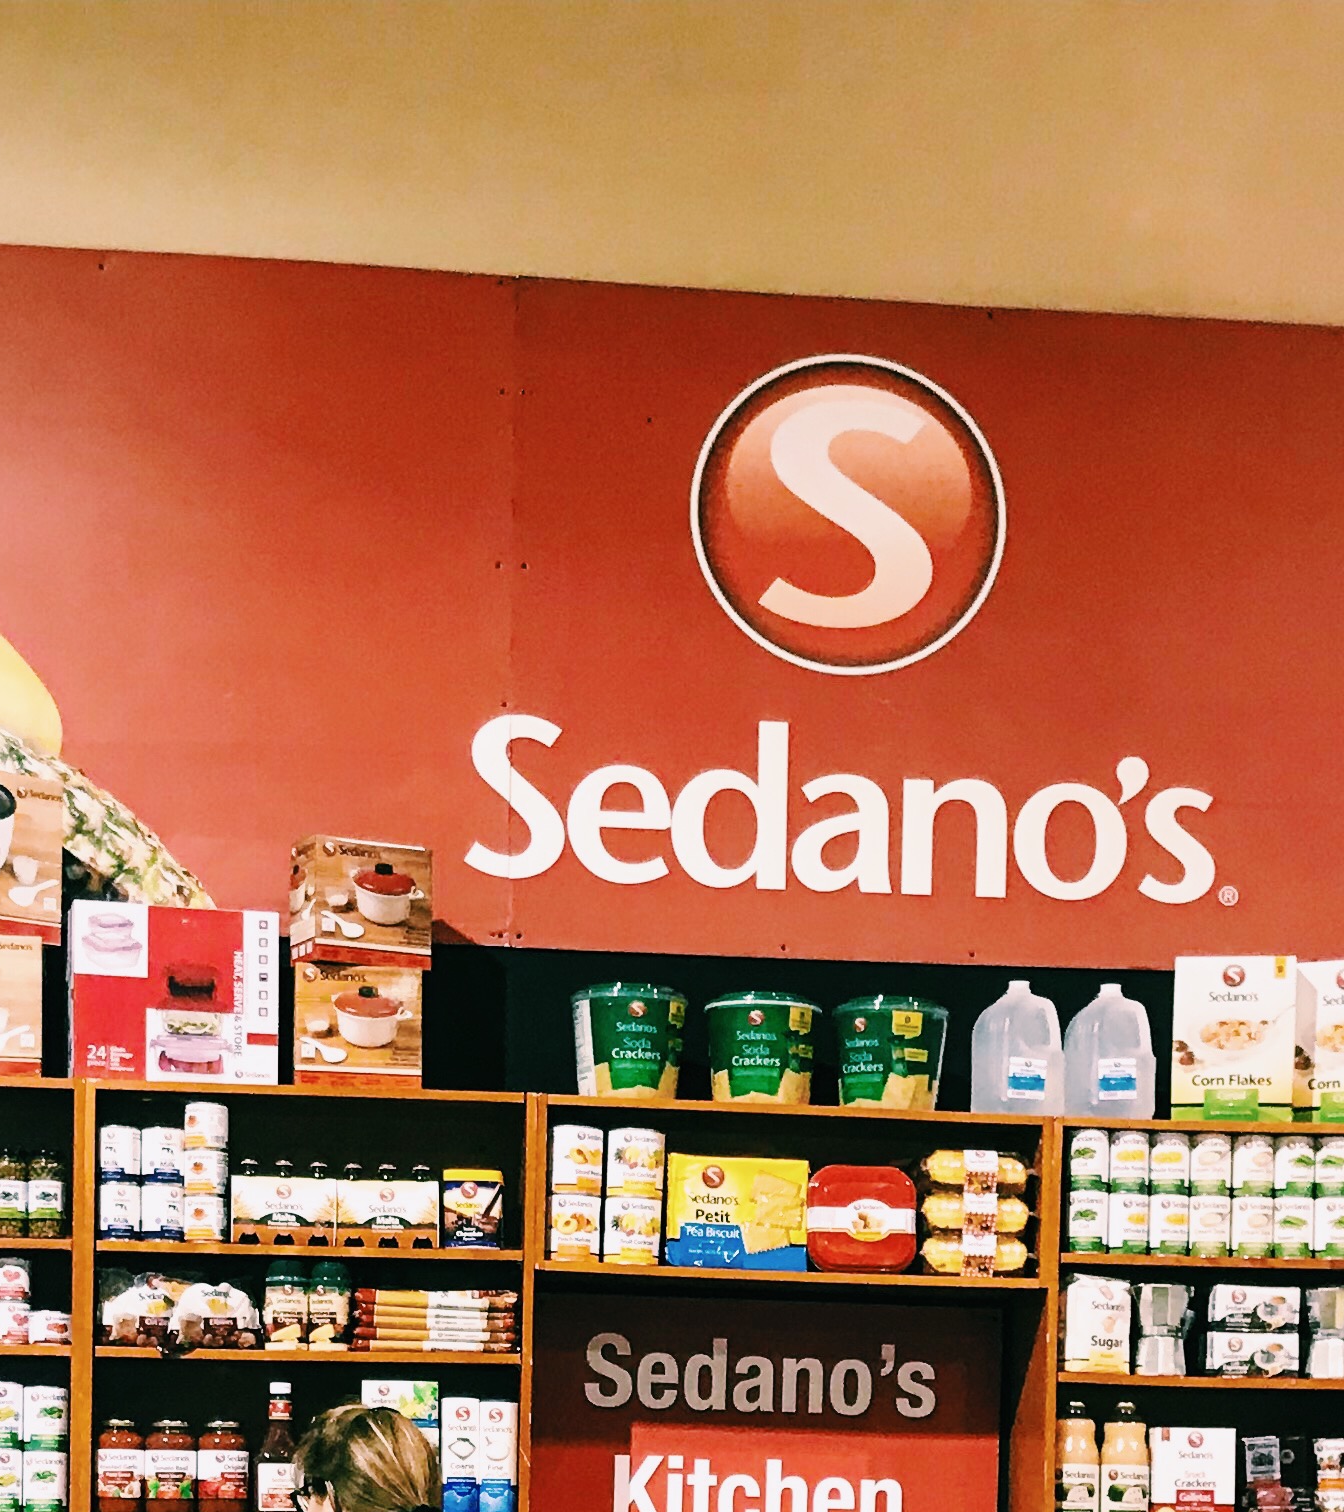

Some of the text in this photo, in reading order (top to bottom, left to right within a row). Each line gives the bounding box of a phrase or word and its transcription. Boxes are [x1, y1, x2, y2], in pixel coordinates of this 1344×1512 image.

[464, 713, 1216, 905] Sedano's
[623, 1036, 651, 1050] Soda
[742, 1043, 770, 1057] Soda
[86, 1044, 106, 1059] 24
[611, 1047, 661, 1061] Crackers
[848, 1050, 874, 1063] Soda
[731, 1055, 781, 1067] Crackers
[842, 1061, 884, 1074] Crackers
[1191, 1073, 1272, 1088] Corn Flakes
[1308, 1077, 1341, 1091] Corn
[695, 1208, 731, 1224] Petit
[706, 1225, 741, 1239] Biscuit
[1090, 1334, 1124, 1350] Sugar
[583, 1332, 937, 1419] Sedano's
[1174, 1478, 1217, 1488] Crackers
